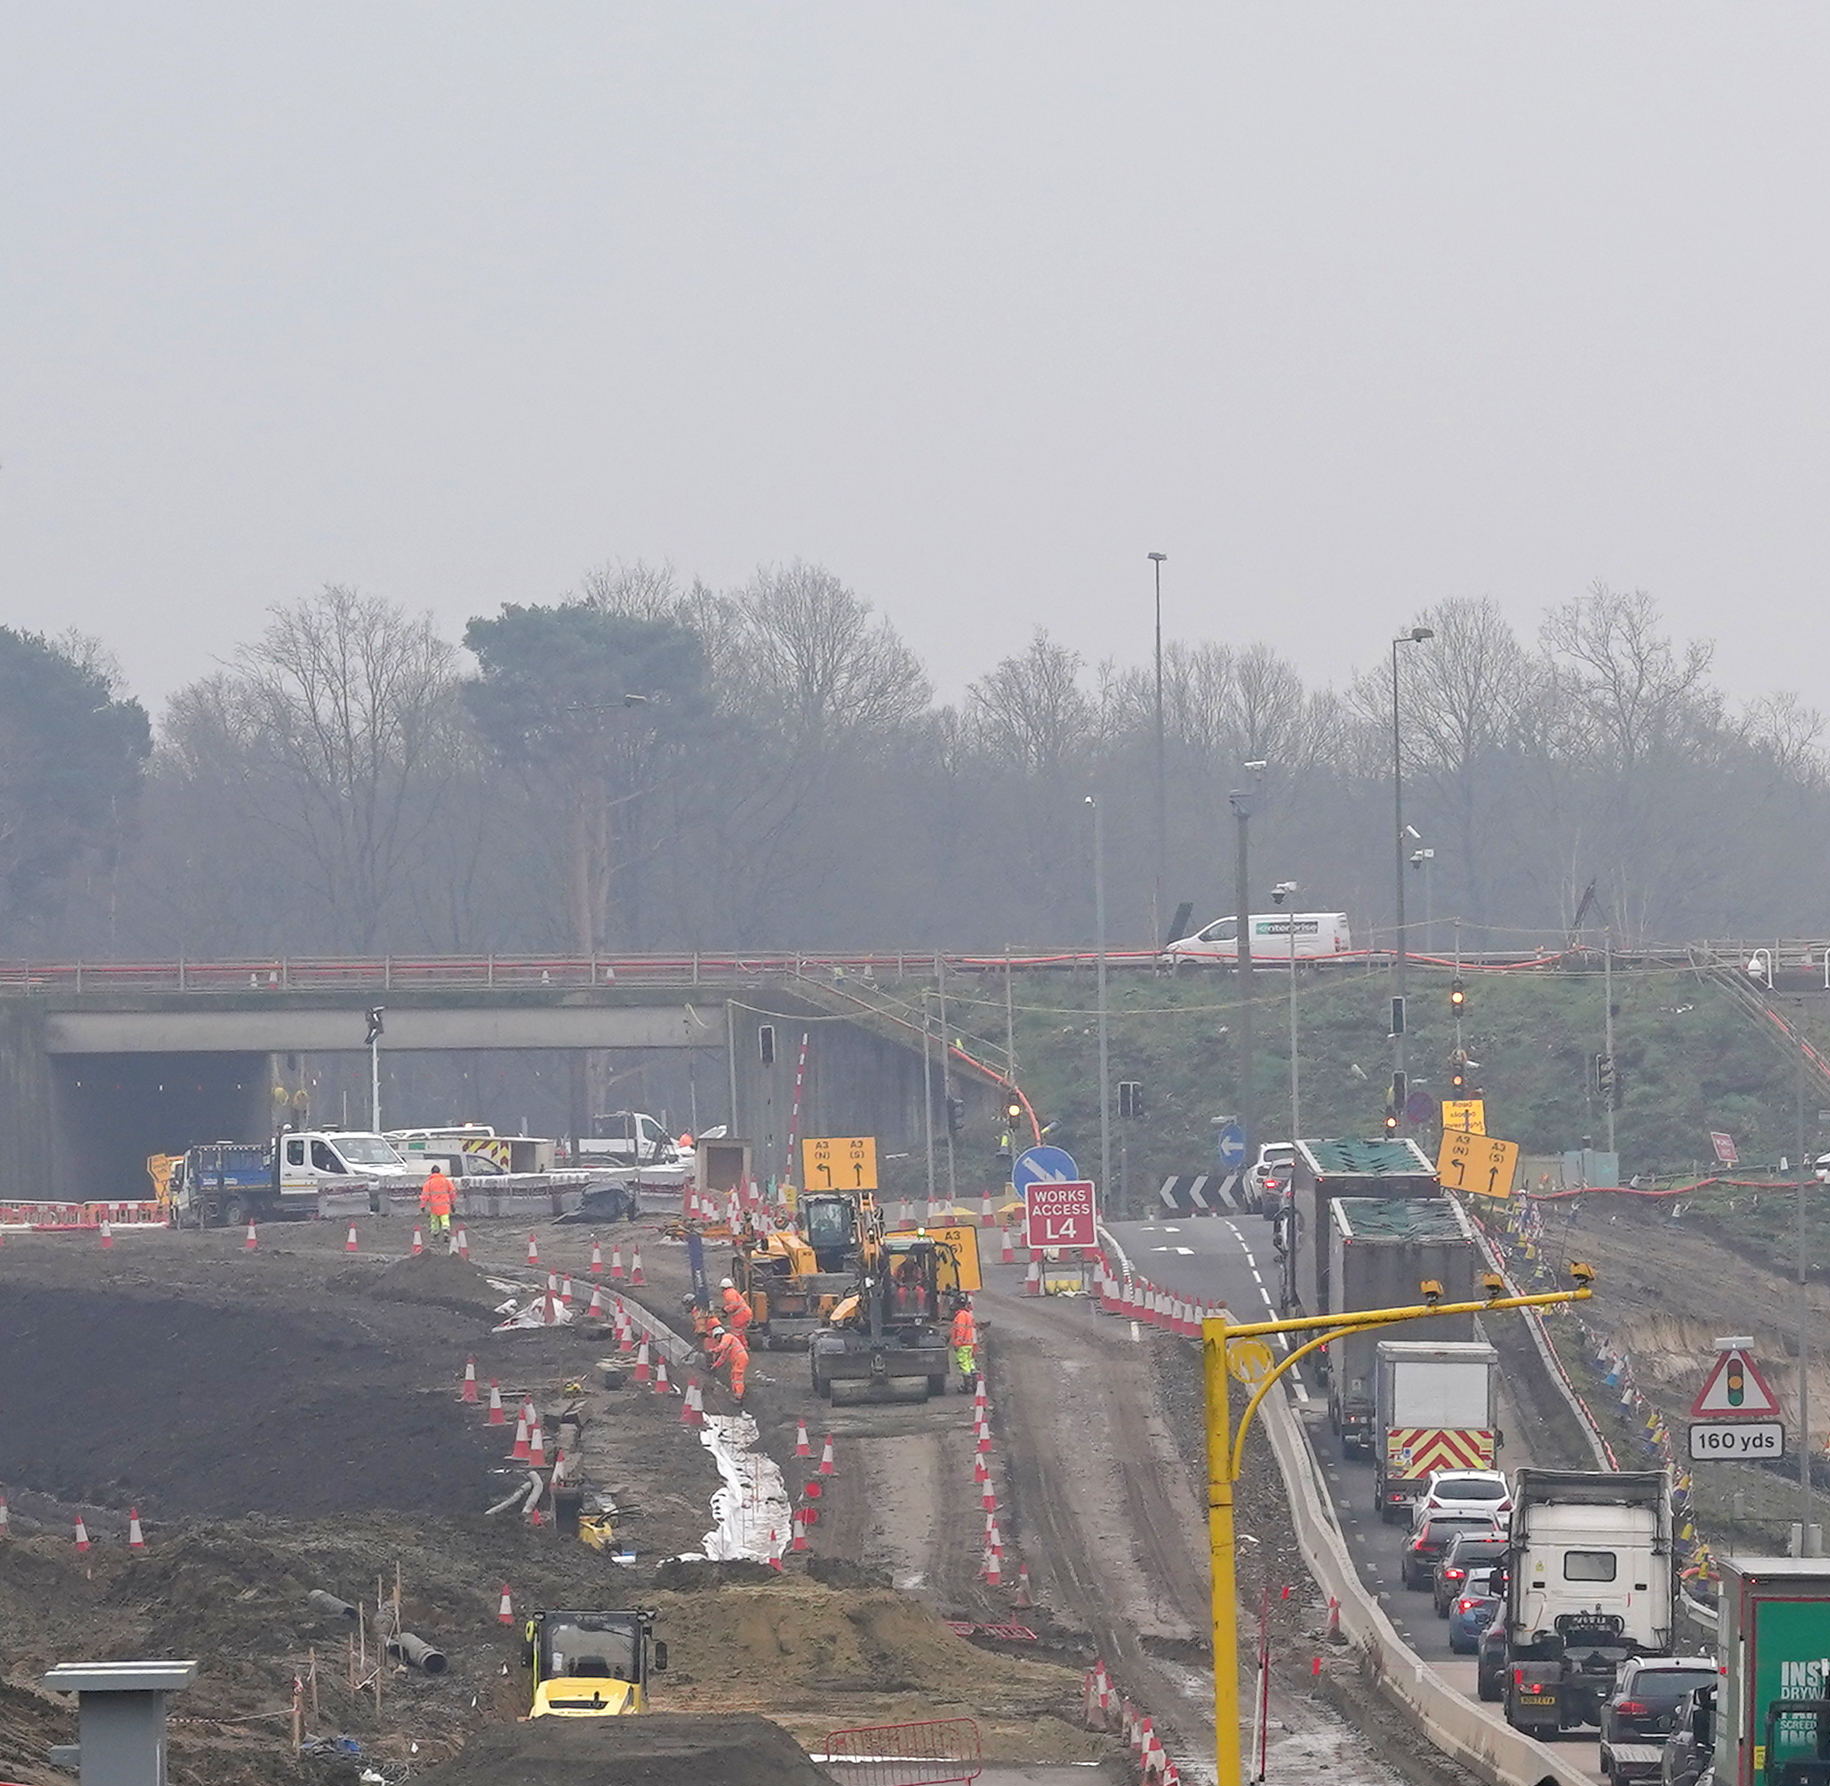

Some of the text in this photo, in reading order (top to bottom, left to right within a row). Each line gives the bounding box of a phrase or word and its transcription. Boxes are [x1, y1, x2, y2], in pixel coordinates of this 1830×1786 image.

[1456, 1135, 1470, 1144] A3
[1491, 1142, 1506, 1152] A3
[1034, 1189, 1086, 1202] WORKS
[1032, 1203, 1091, 1216] ACCESS
[944, 1230, 961, 1241] A3
[1045, 1218, 1077, 1240] L4
[1698, 1432, 1775, 1452] 160 yds
